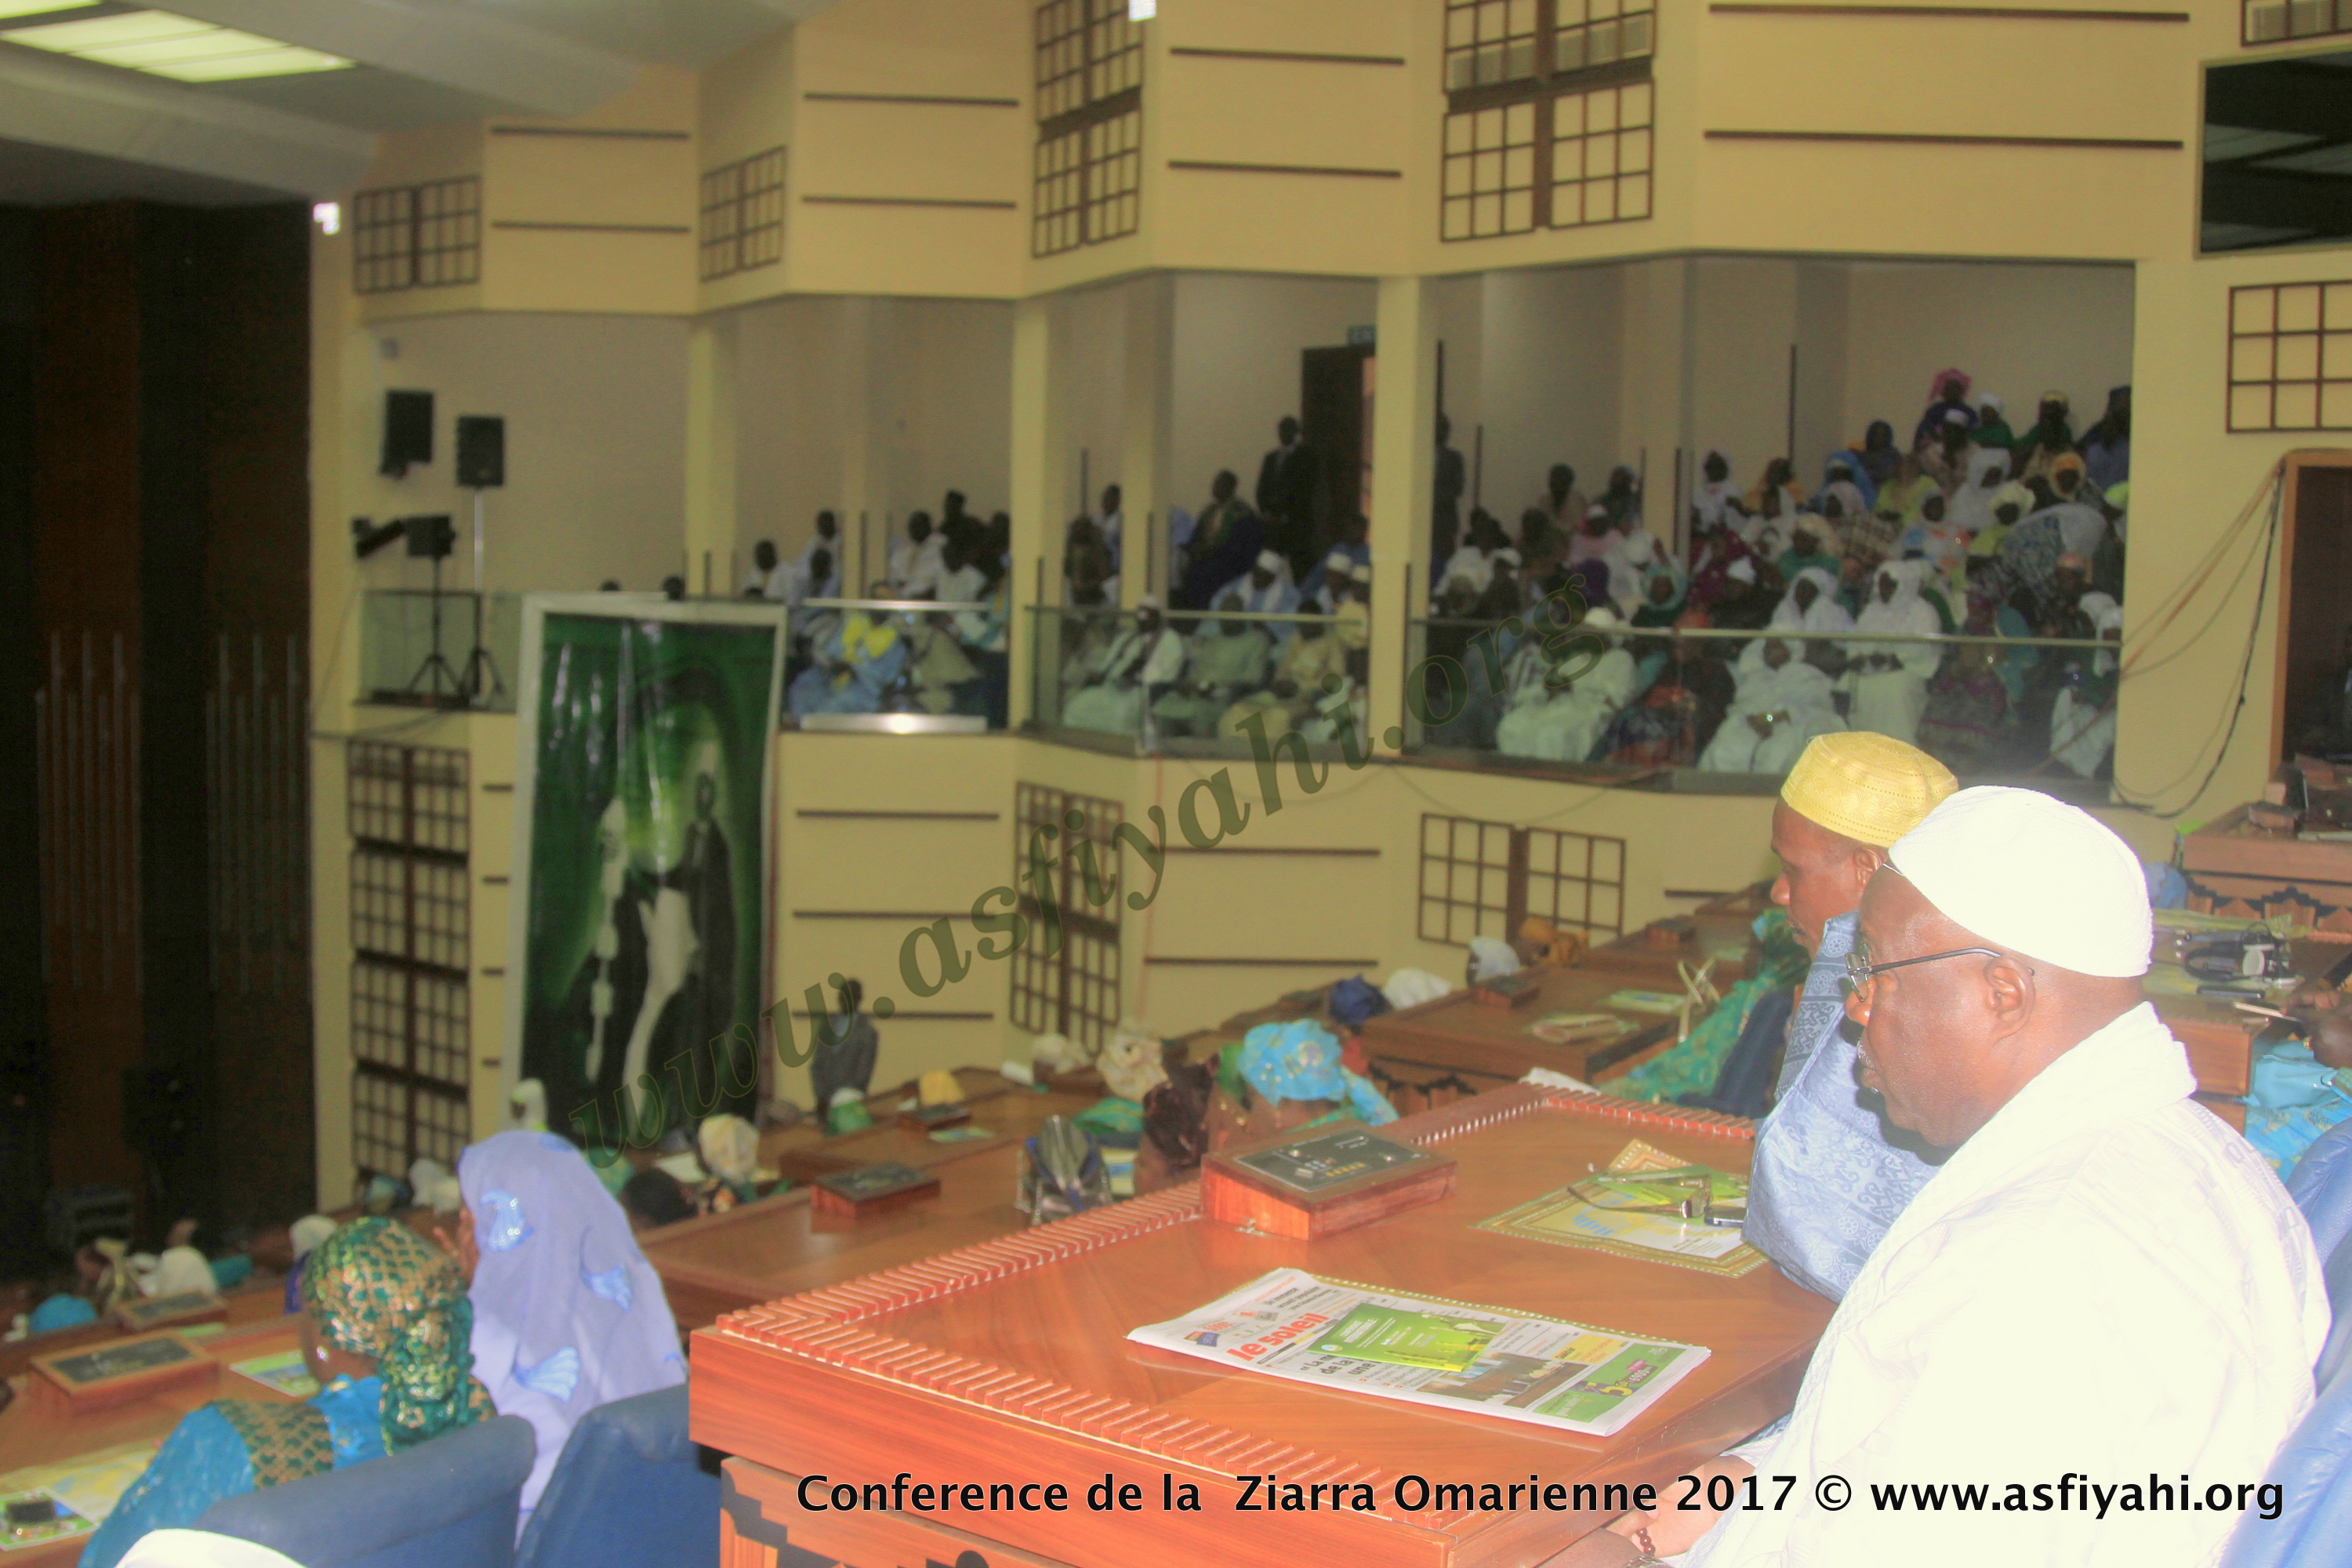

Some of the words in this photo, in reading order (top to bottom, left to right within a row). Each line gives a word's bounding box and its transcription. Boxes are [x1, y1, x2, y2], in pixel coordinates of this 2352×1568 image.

[1225, 1343, 1268, 1361] le
[1257, 1312, 1331, 1346] soleil
[1319, 1363, 1343, 1375] de
[1347, 1362, 1377, 1375] une
